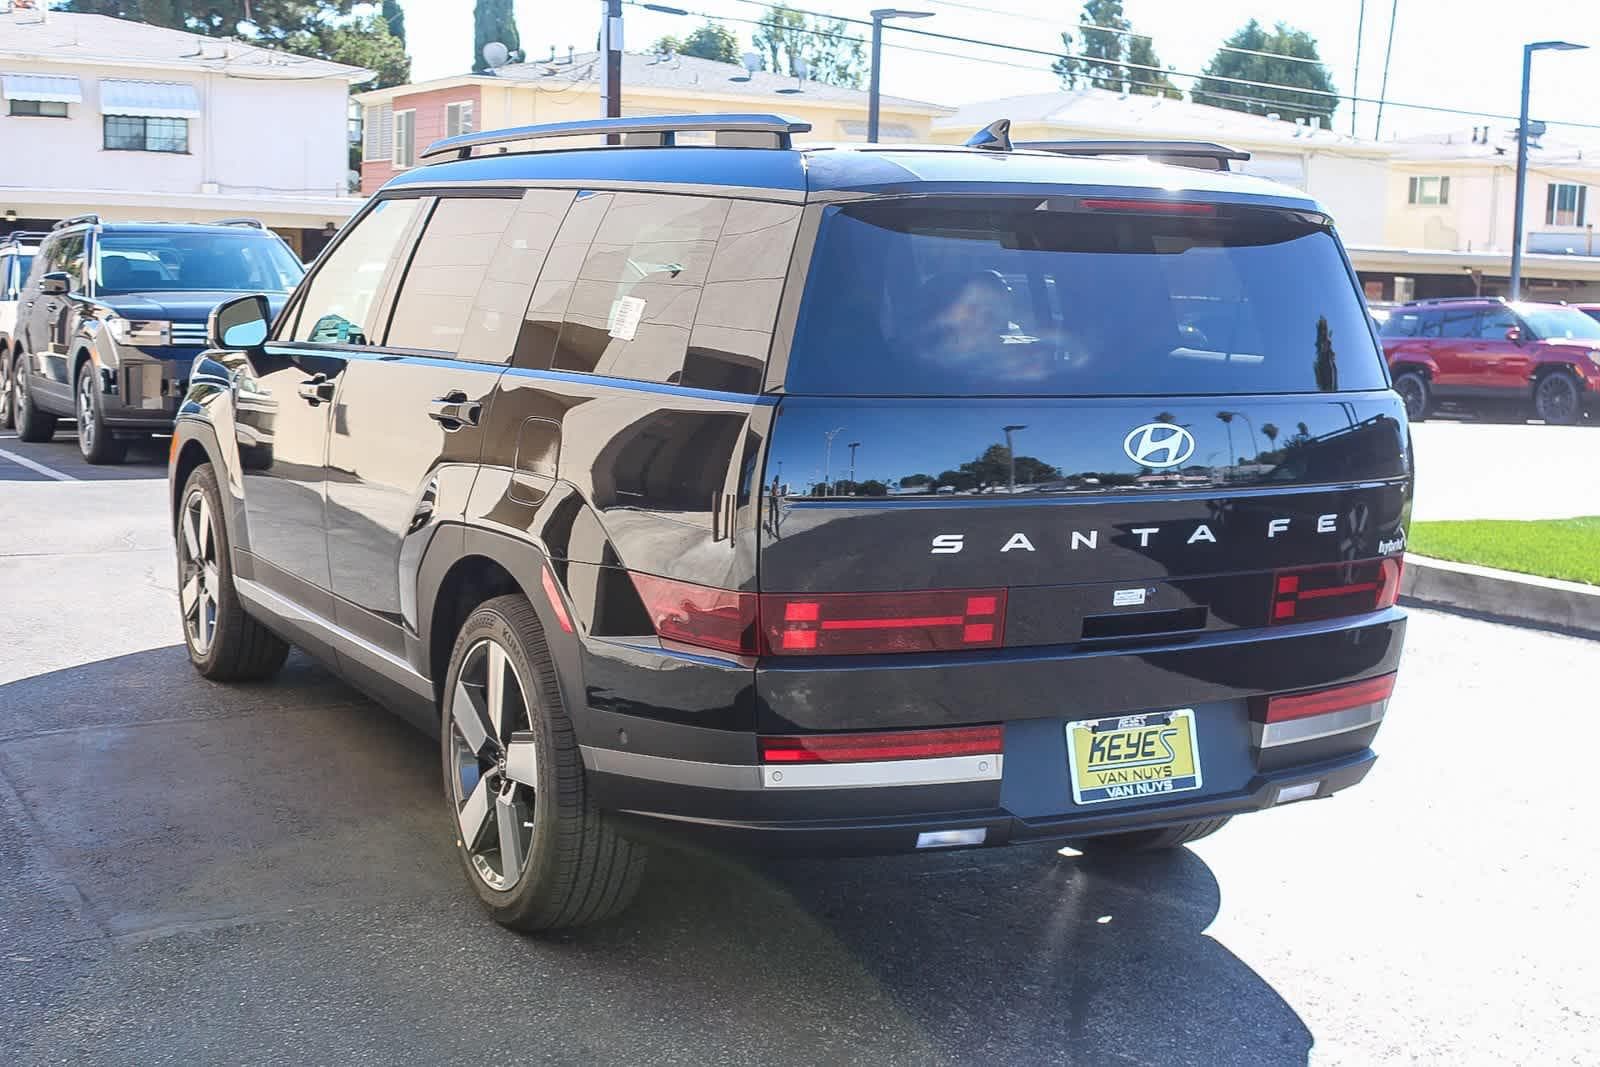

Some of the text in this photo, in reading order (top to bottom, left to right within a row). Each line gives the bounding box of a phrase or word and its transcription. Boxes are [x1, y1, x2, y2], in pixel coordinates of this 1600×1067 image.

[931, 513, 1338, 554] SANTA FE
[1088, 729, 1177, 766] KEYES
[1097, 766, 1173, 785] VAN NUYS
[1106, 780, 1173, 798] VAN NUYS
